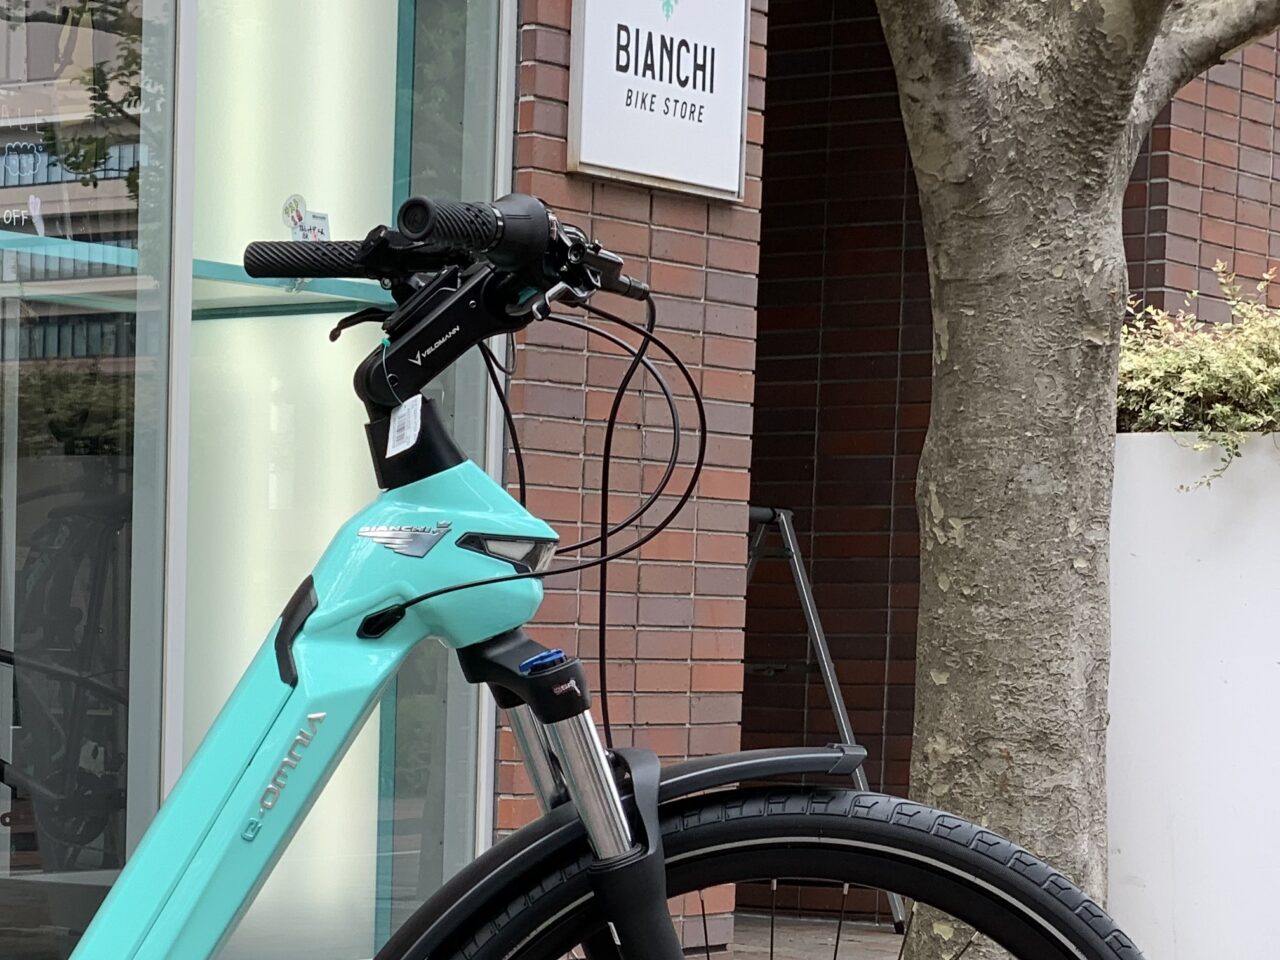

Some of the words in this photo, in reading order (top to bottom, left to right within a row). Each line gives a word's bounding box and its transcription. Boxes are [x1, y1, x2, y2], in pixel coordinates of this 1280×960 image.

[615, 23, 715, 94] BIANCHI
[625, 88, 656, 112] BIKE
[663, 97, 705, 123] STORE
[3, 208, 29, 226] OFF
[421, 325, 460, 358] VELOMANN
[358, 525, 433, 533] BIANCHI
